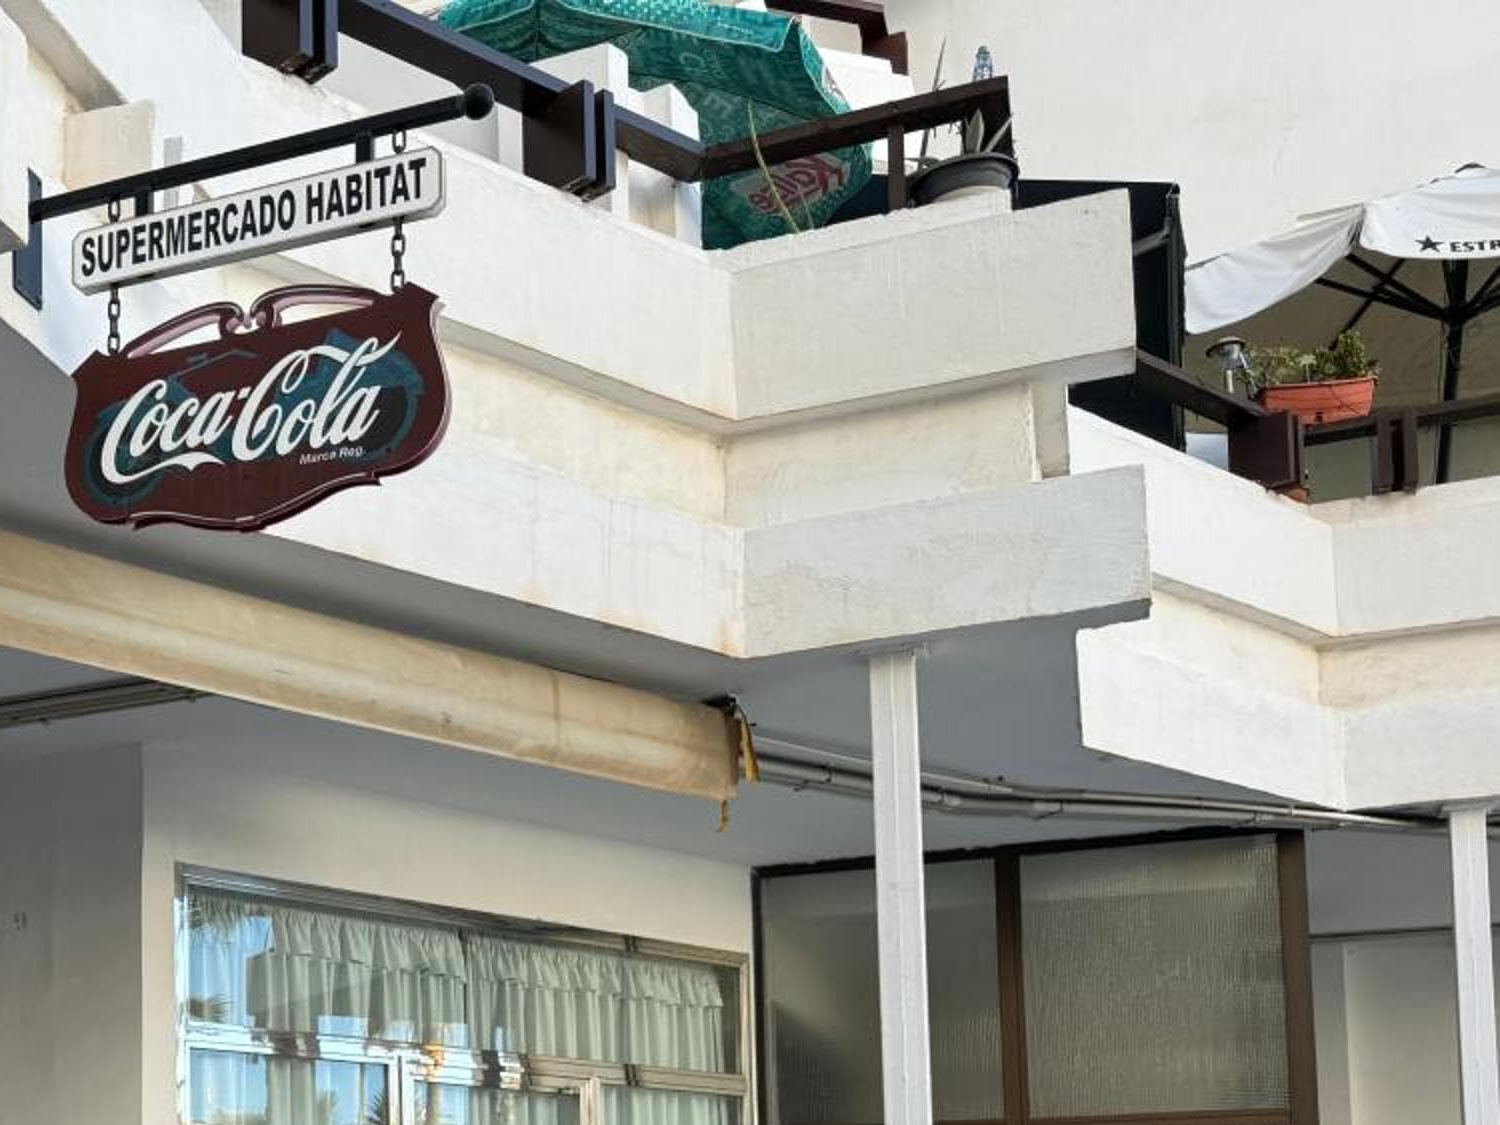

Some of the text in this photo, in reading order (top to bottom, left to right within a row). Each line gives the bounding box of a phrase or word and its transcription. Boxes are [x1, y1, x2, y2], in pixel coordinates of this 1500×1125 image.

[81, 157, 427, 277] SUPERMERCADO HABITAT
[100, 329, 402, 486] Coca-Cola
[299, 450, 337, 464] Marca
